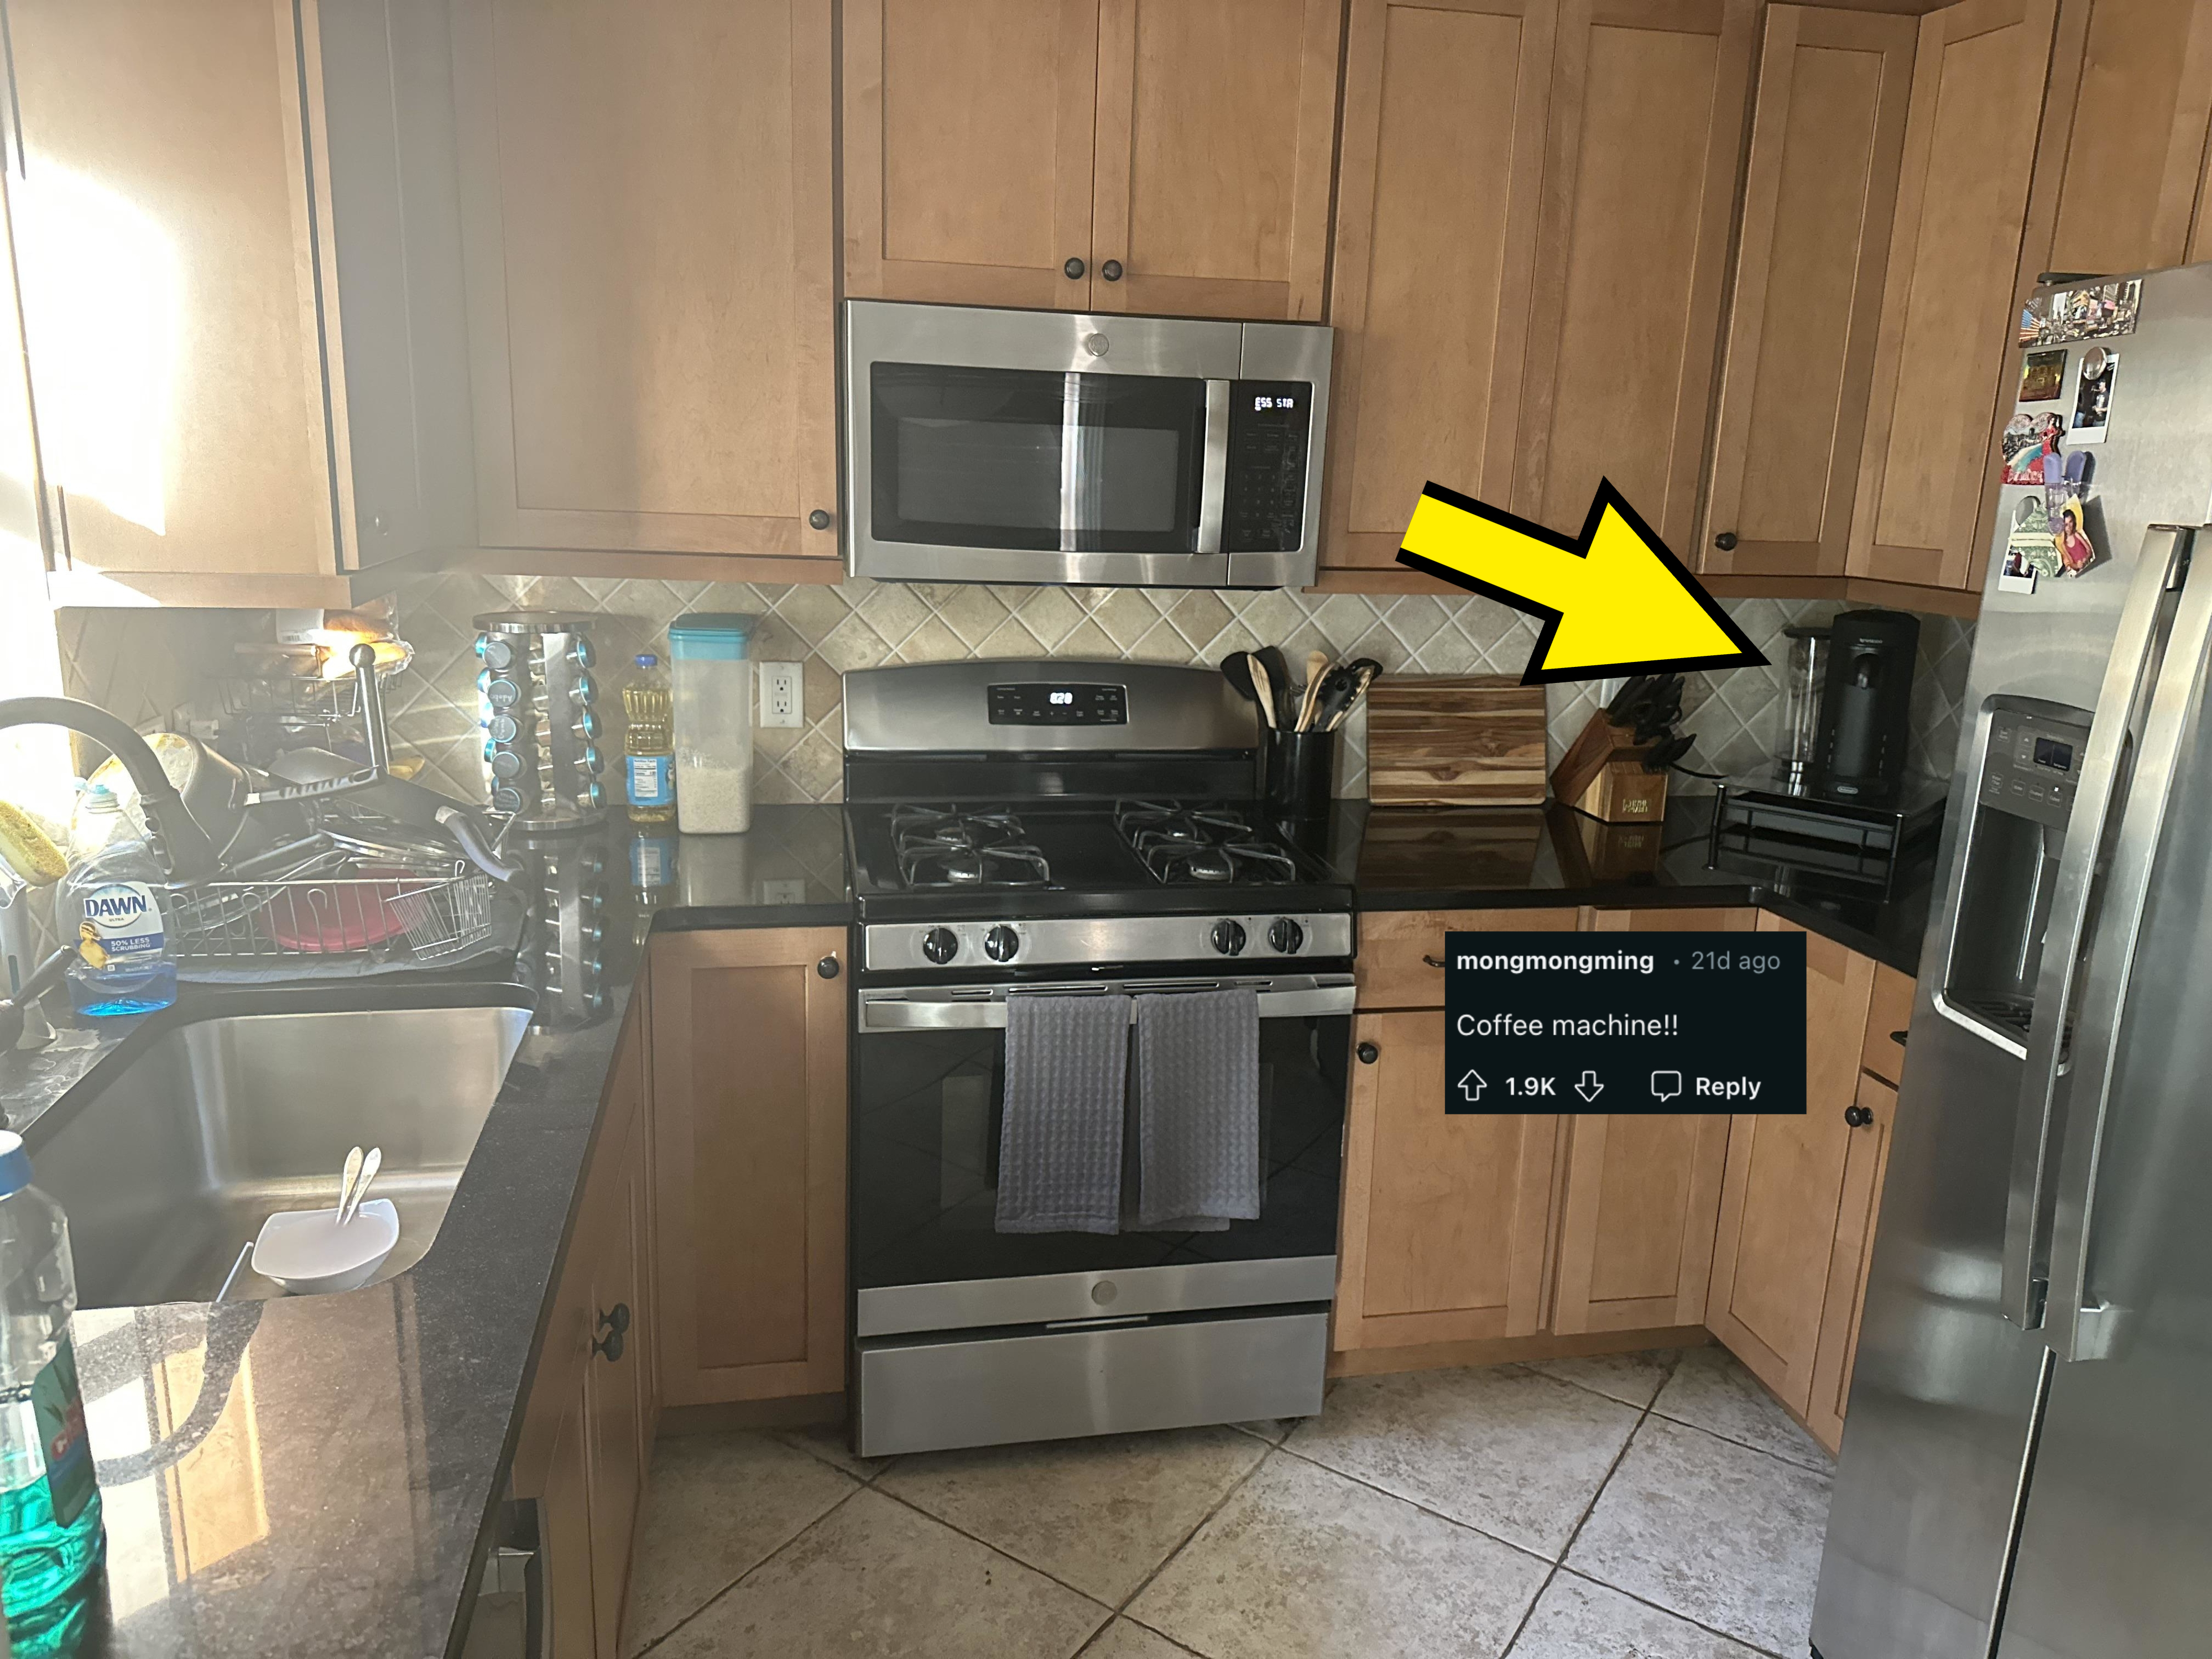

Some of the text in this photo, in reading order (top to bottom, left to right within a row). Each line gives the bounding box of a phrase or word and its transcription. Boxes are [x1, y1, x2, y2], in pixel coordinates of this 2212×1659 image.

[85, 895, 147, 917] DAWN
[130, 937, 150, 945] LESS
[111, 943, 150, 952] SCRUBBING
